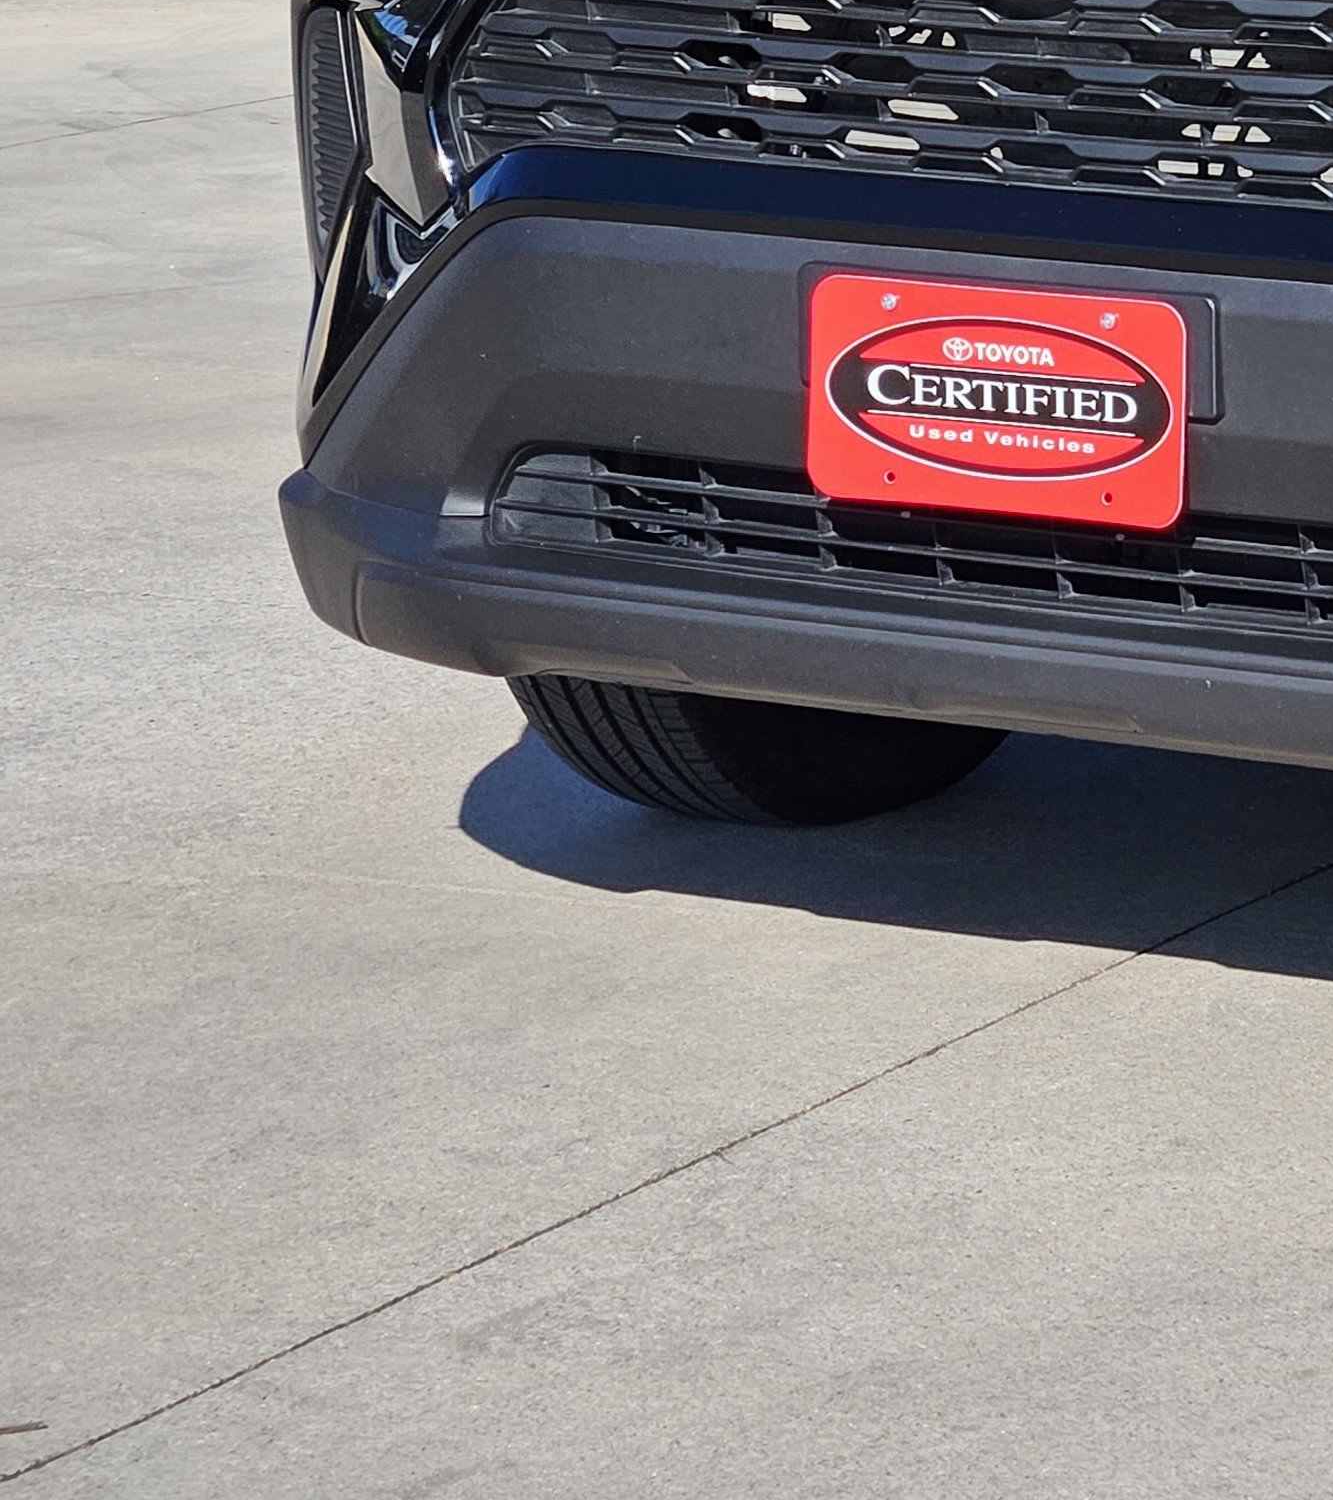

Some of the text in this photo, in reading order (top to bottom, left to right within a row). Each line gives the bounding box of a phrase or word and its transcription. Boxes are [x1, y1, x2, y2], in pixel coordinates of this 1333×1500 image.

[973, 342, 1055, 367] TOYOTA
[867, 364, 1138, 423] CERTIFIED
[909, 424, 1096, 454] Used Vehicles
